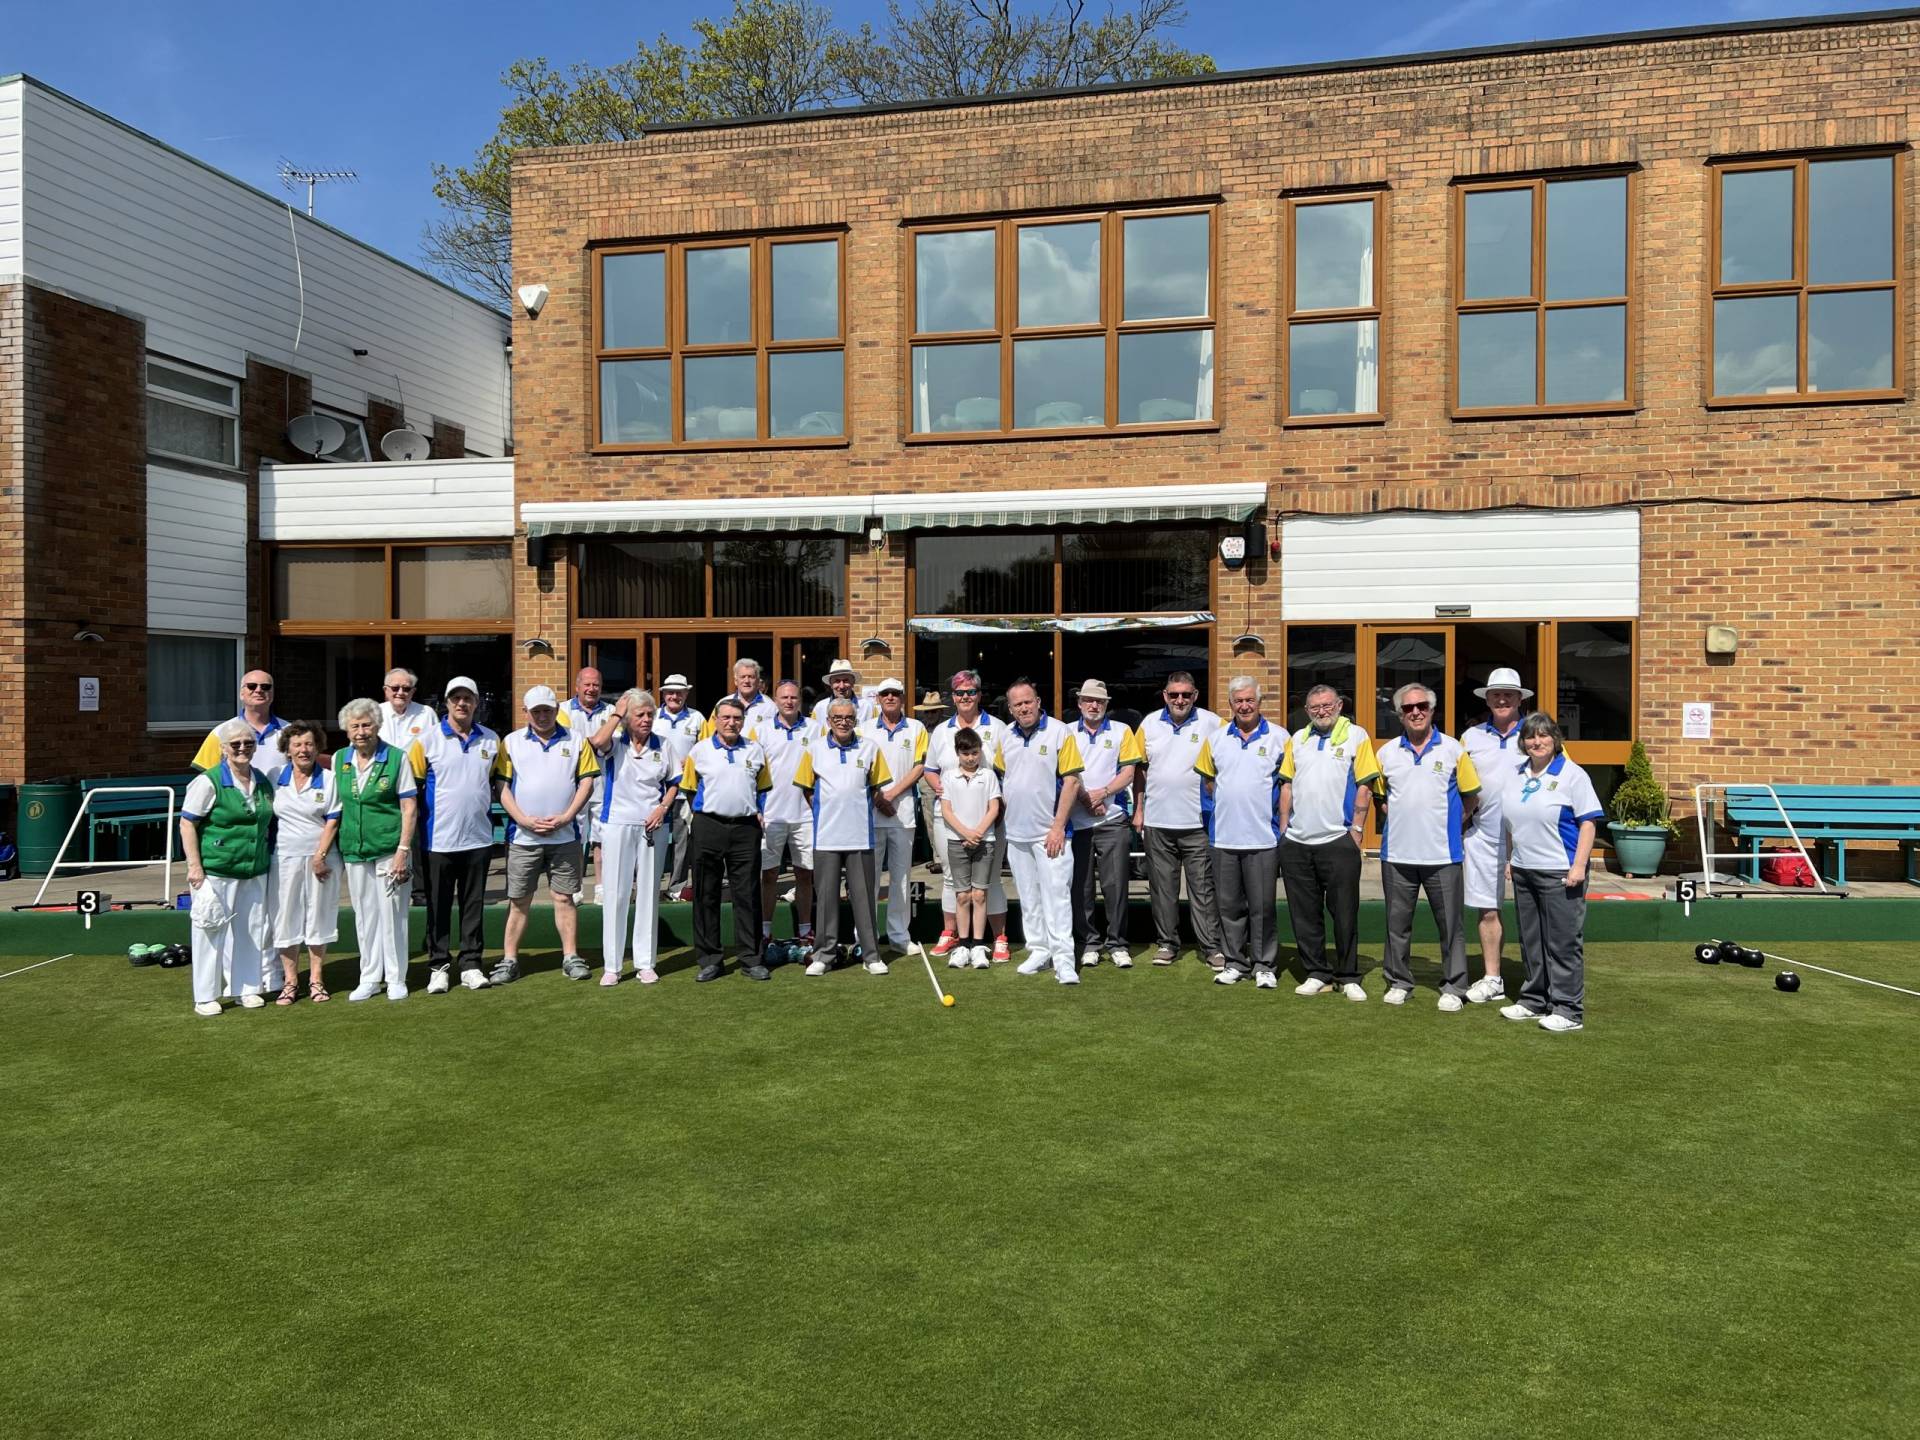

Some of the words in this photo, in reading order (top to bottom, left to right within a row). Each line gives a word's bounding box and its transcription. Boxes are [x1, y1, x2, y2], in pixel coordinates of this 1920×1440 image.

[910, 882, 921, 901] 4
[1680, 881, 1694, 900] 5
[80, 891, 96, 912] 3
